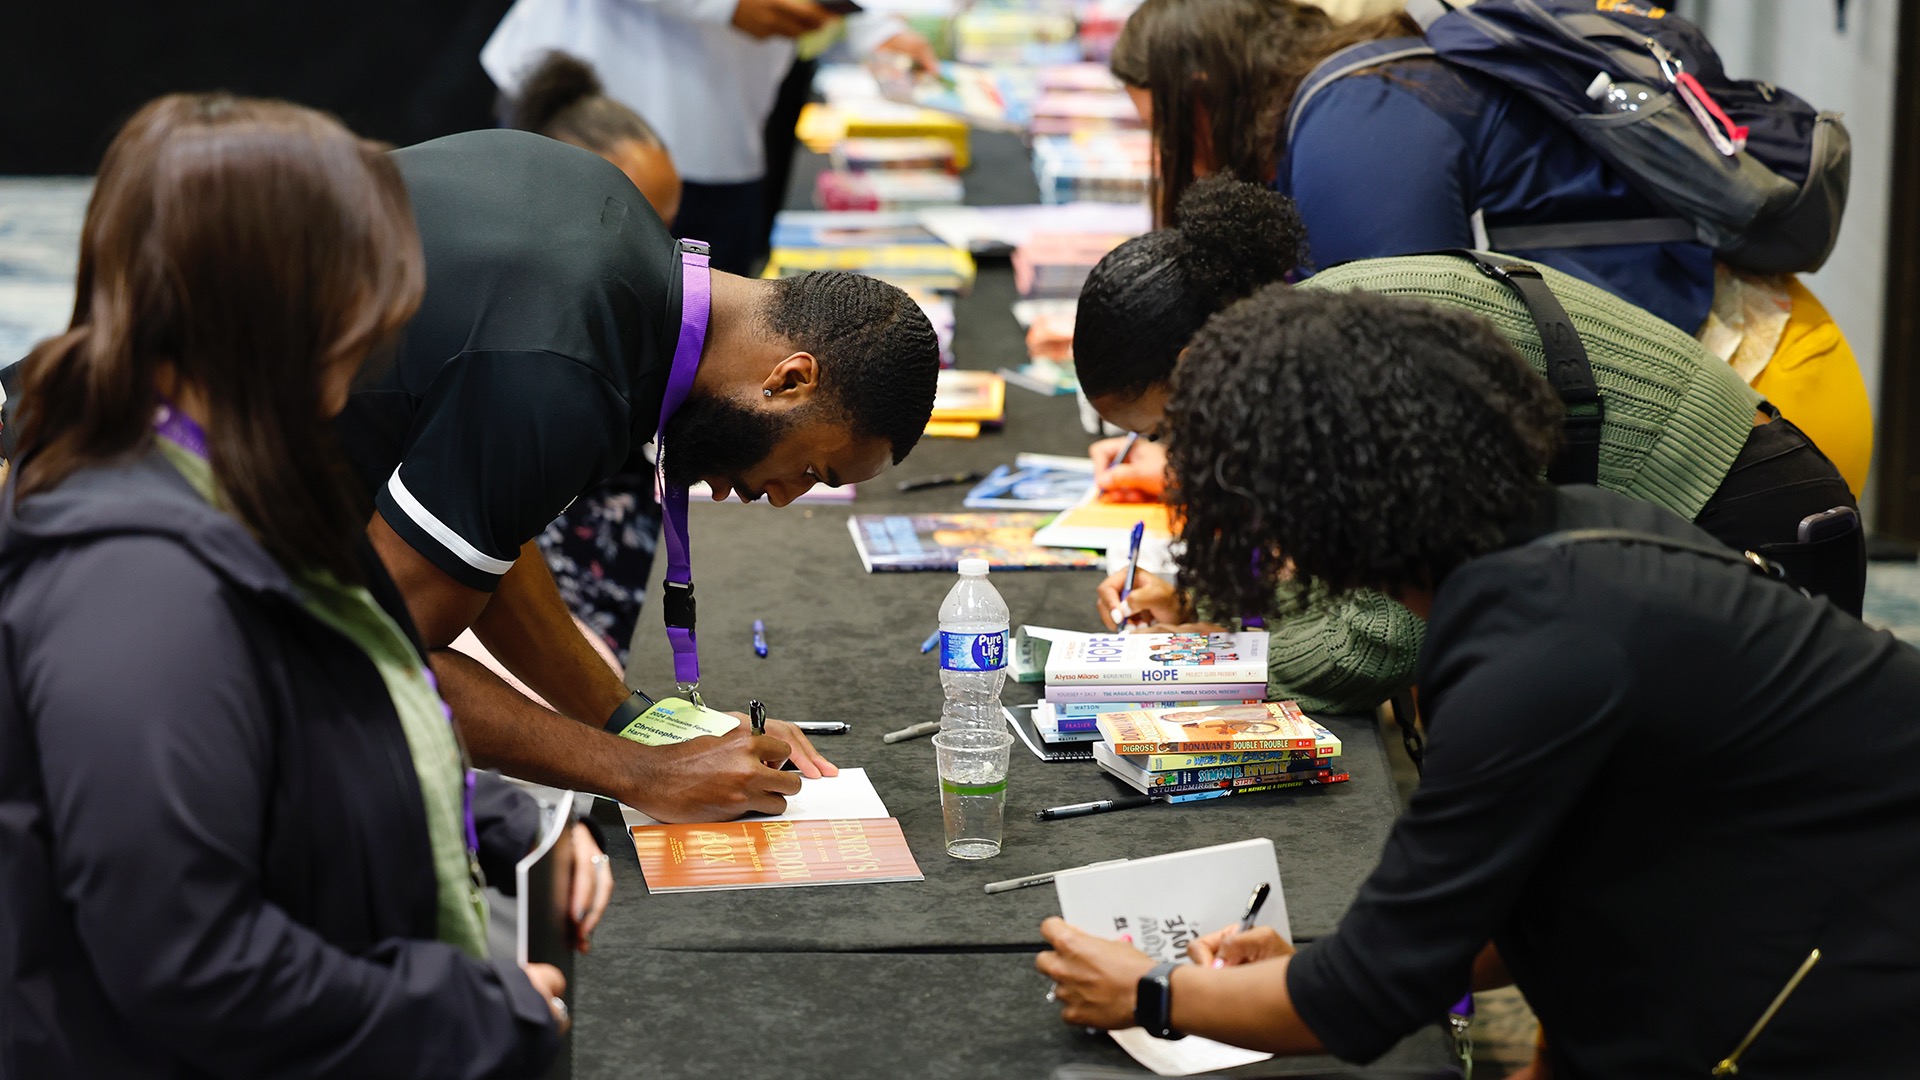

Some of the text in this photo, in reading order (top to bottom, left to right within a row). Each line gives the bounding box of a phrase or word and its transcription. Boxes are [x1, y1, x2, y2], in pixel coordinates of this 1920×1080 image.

[978, 634, 1001, 646] Pure
[981, 644, 1000, 659] Life
[1086, 637, 1125, 663] HOPE
[1054, 673, 1076, 681] Alyssa
[1142, 669, 1178, 681] HOPE
[627, 728, 651, 739] Harris
[633, 722, 682, 741] Christopher
[1183, 742, 1231, 751] DONAVAN'S
[1233, 741, 1258, 749] DOUBLE
[1260, 739, 1289, 749] TROUBLE
[1197, 768, 1233, 782] SIMON
[1233, 765, 1243, 778] B.
[1152, 782, 1212, 794] STOUDEMIRE
[697, 833, 736, 865] BOX
[761, 820, 812, 880] REEDOM
